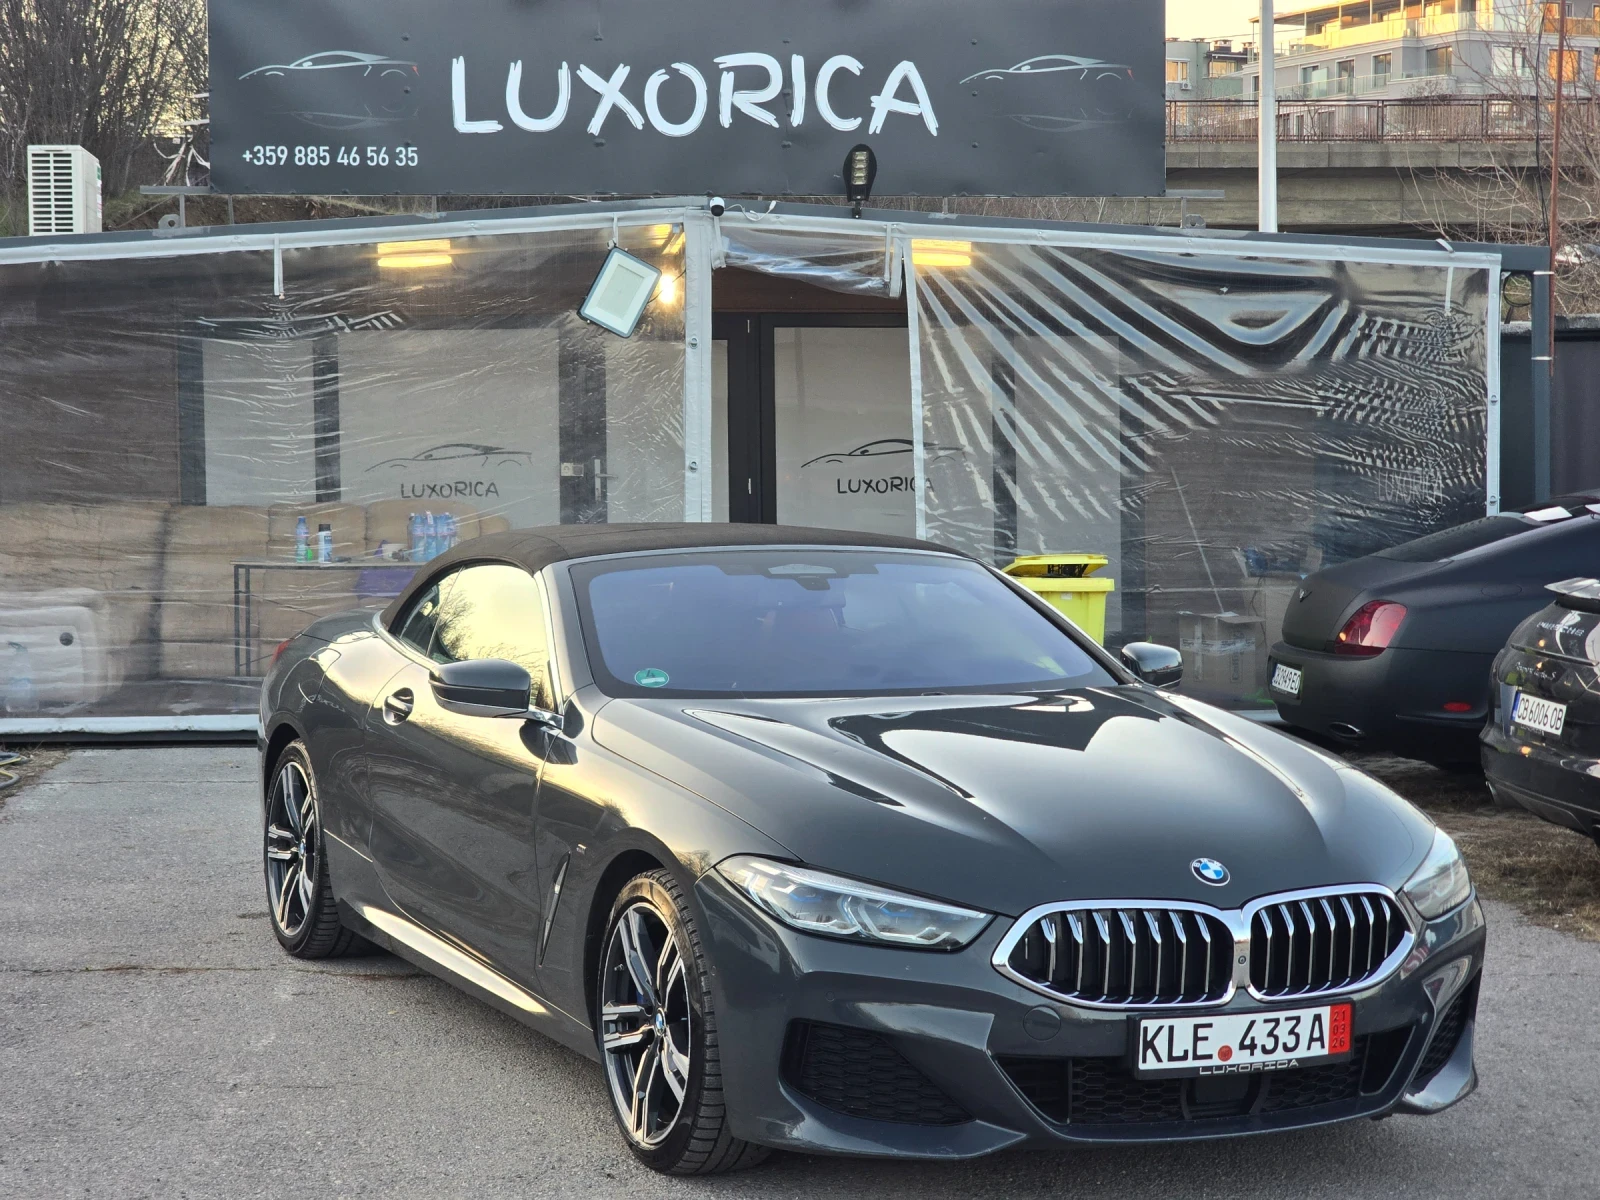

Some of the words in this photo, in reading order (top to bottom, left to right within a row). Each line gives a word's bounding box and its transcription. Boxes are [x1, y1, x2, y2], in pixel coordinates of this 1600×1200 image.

[450, 52, 938, 137] LUXORICA
[242, 145, 288, 166] +359
[294, 145, 330, 166] 885
[337, 146, 361, 166] 46
[367, 146, 389, 167] 56
[395, 146, 418, 167] 35
[400, 481, 500, 499] LUXORICA
[1141, 1022, 1214, 1064] KLE
[1199, 1058, 1299, 1075] LUXORICA
